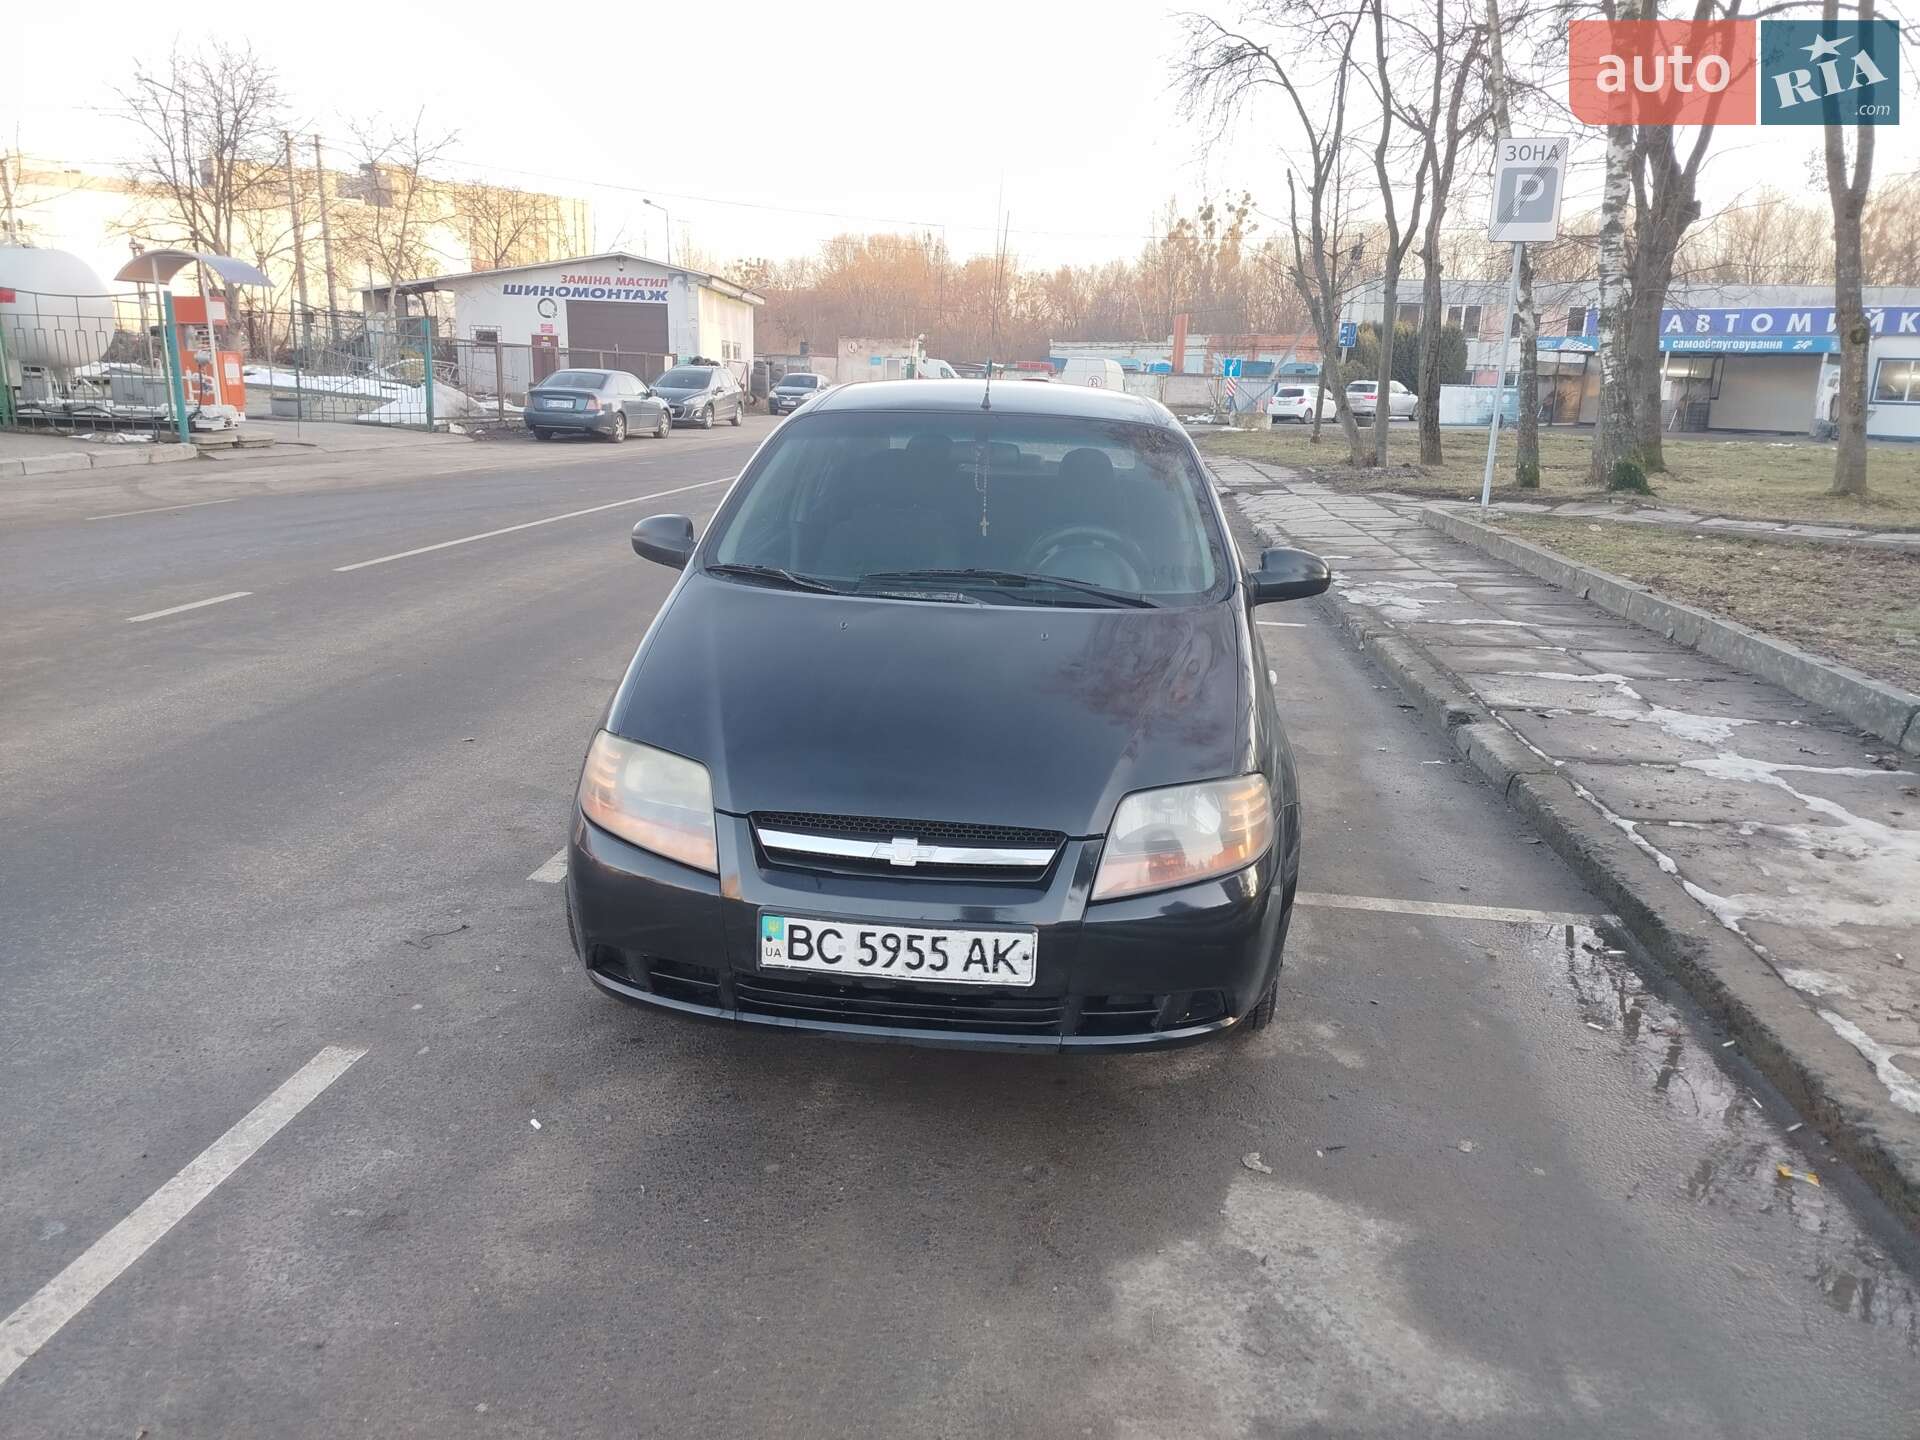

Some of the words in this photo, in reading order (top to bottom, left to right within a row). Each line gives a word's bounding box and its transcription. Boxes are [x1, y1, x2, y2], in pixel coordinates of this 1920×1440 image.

[1505, 144, 1560, 161] ЗОНА
[1513, 174, 1545, 217] P
[560, 274, 611, 286] ЗАМІНА
[615, 276, 669, 288] МАСТИЛ
[502, 284, 669, 302] ШИНОМОНТАЖ
[1672, 338, 1783, 352] самообслуговування
[765, 947, 781, 958] UA
[787, 924, 843, 965] BC
[858, 931, 949, 972] 5955
[962, 937, 1021, 975] AK
